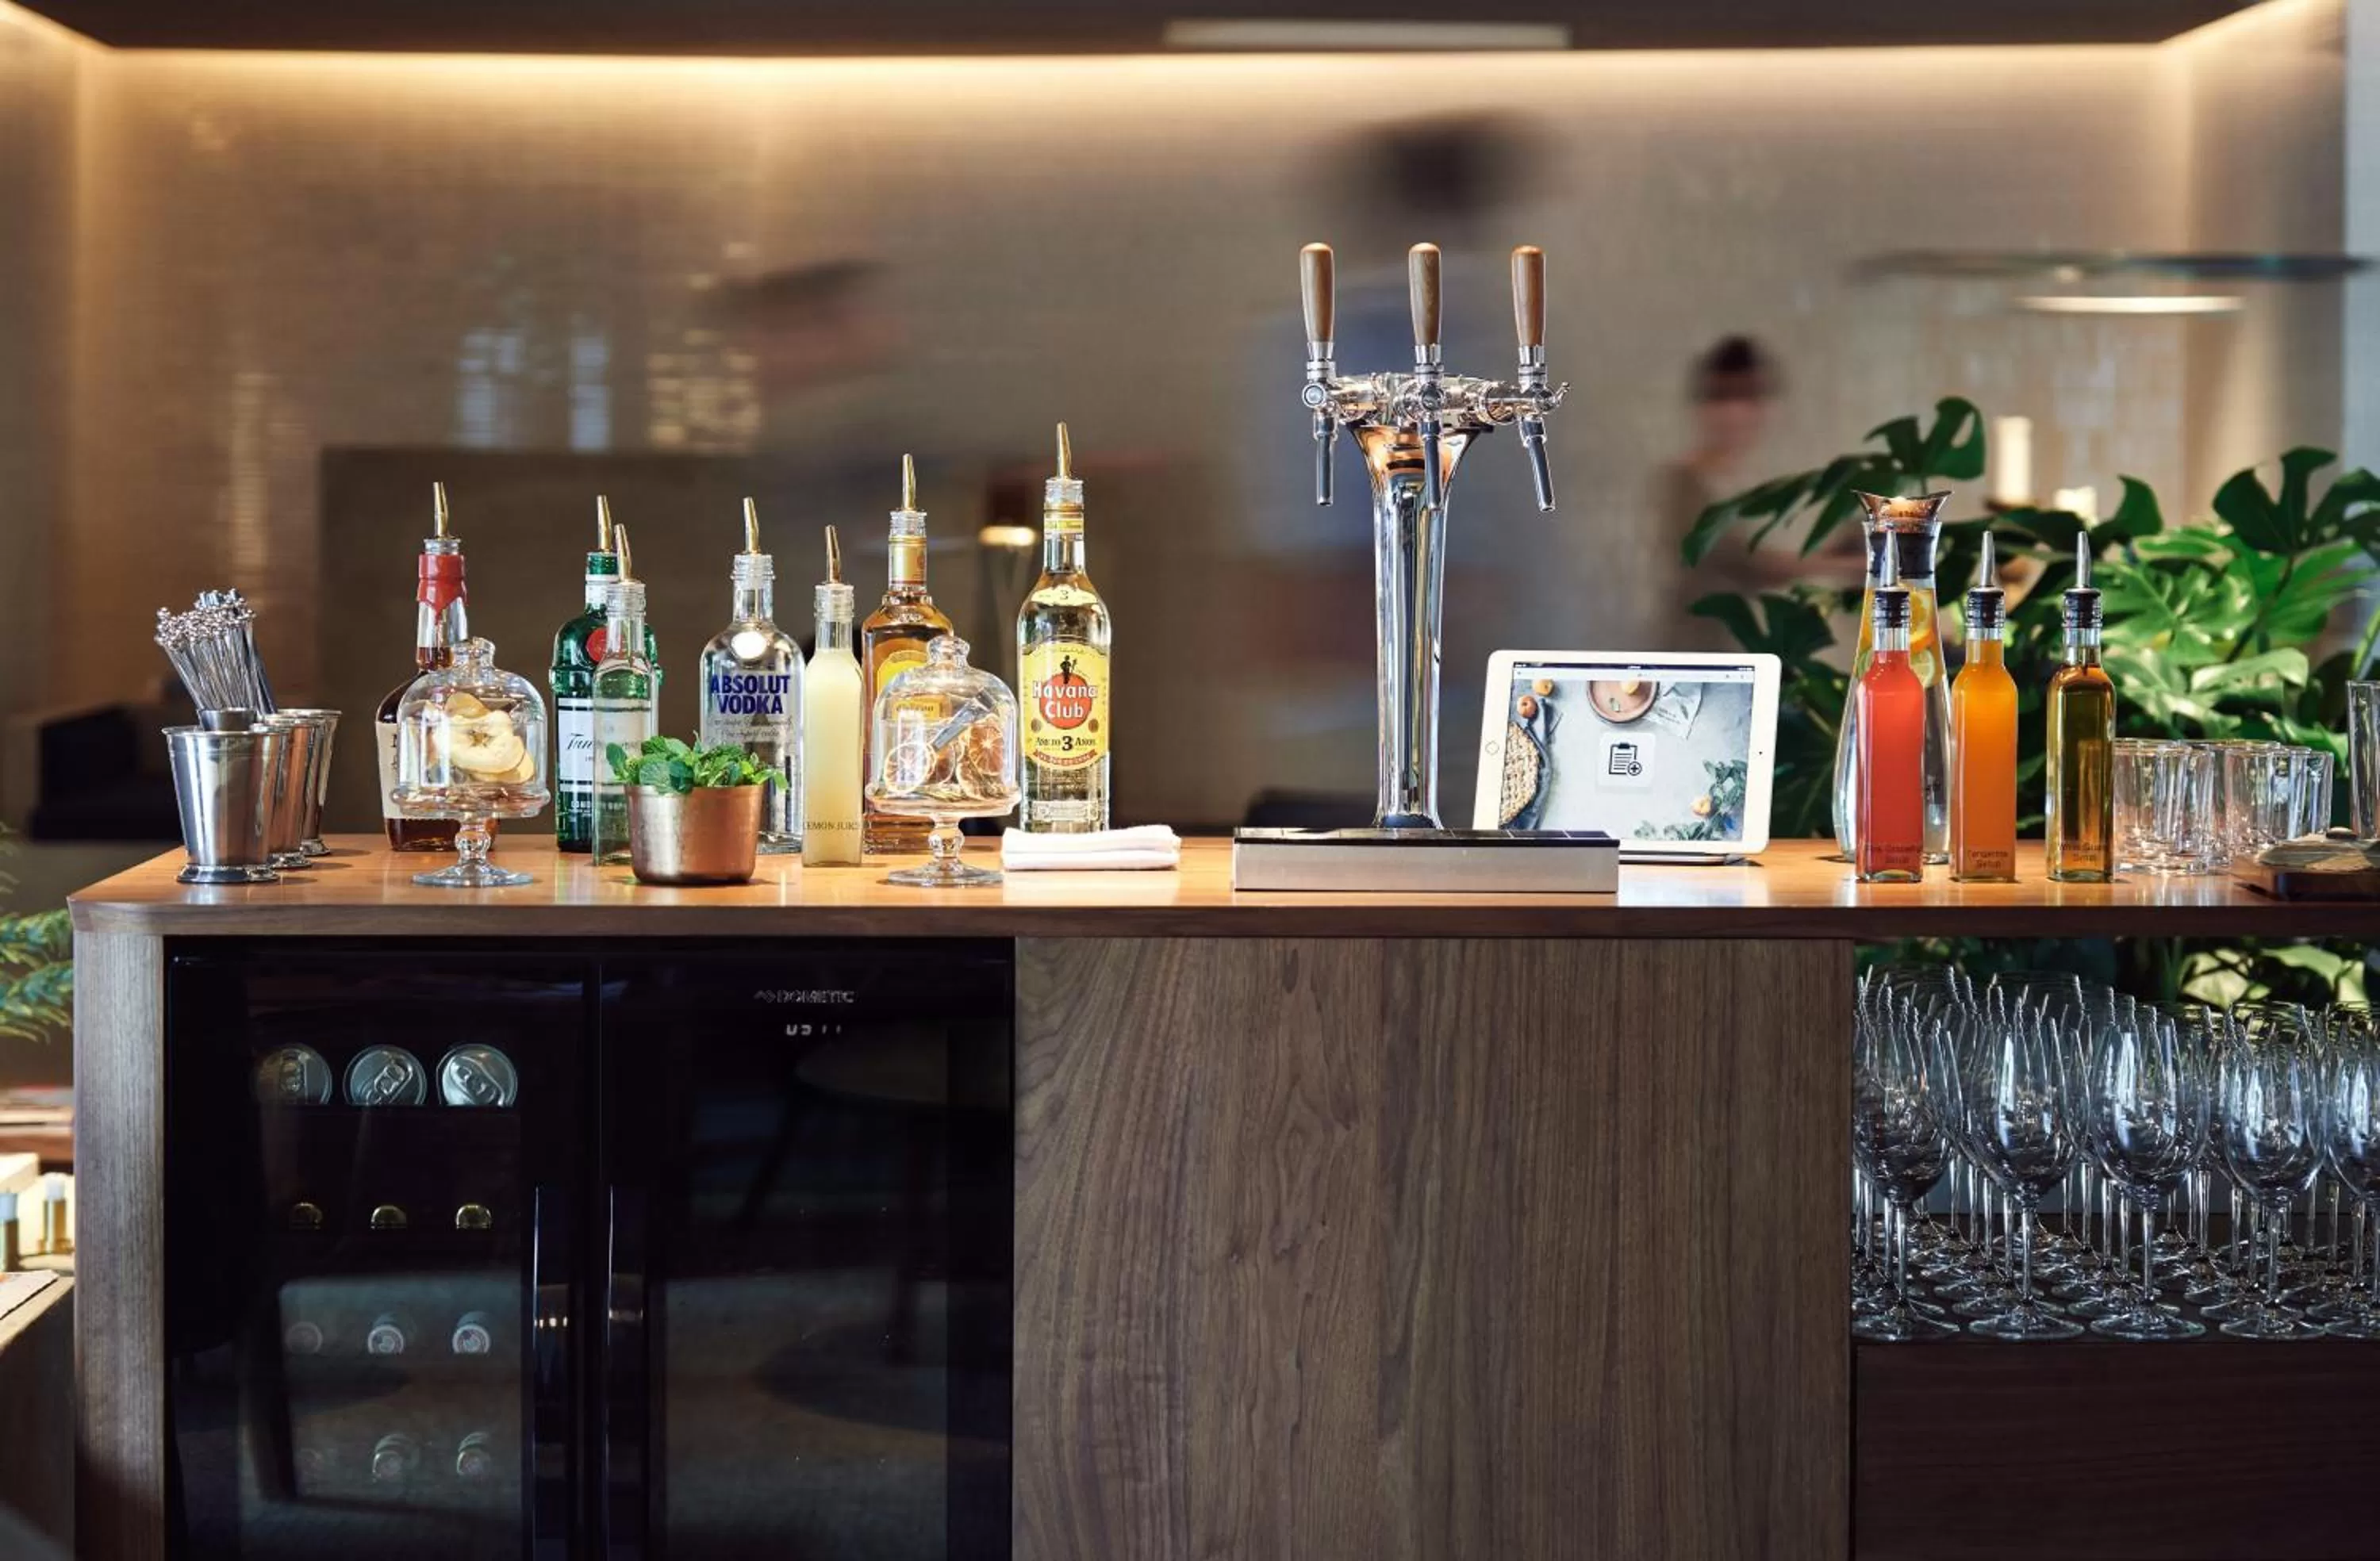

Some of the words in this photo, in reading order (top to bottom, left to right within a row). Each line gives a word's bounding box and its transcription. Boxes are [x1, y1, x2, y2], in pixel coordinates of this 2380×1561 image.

[1059, 589, 1069, 600] 3
[710, 674, 790, 694] ABSOLUT
[1032, 681, 1098, 698] Havana
[717, 694, 783, 714] VODKA
[1044, 700, 1084, 719] Club
[1061, 734, 1074, 751] 3
